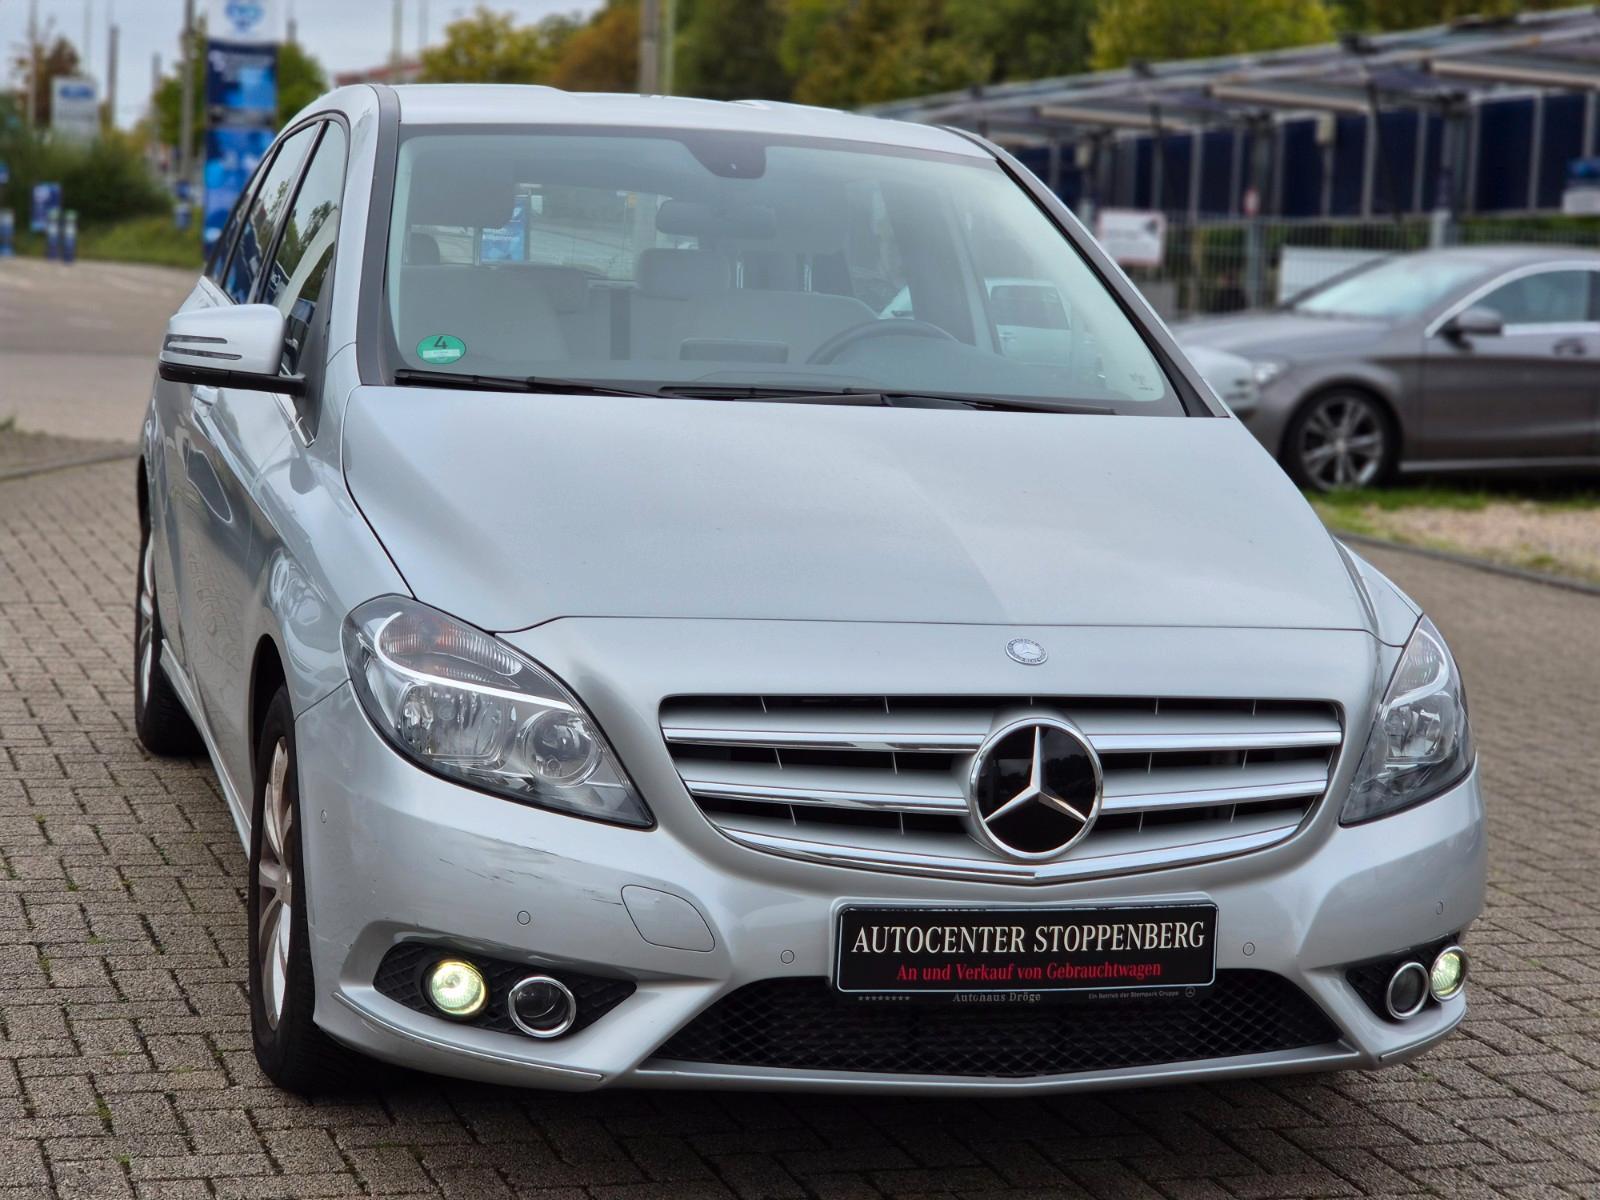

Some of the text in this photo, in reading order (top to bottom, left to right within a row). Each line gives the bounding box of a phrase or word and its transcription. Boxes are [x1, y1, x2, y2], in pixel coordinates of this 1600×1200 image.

[434, 335, 448, 349] 4
[851, 921, 1204, 953] AUTOCENTER STOPPENBERG
[896, 961, 1161, 981] An und Verkauf von Gebrauchtwagen
[952, 991, 1041, 1004] Autohaus Dröge
